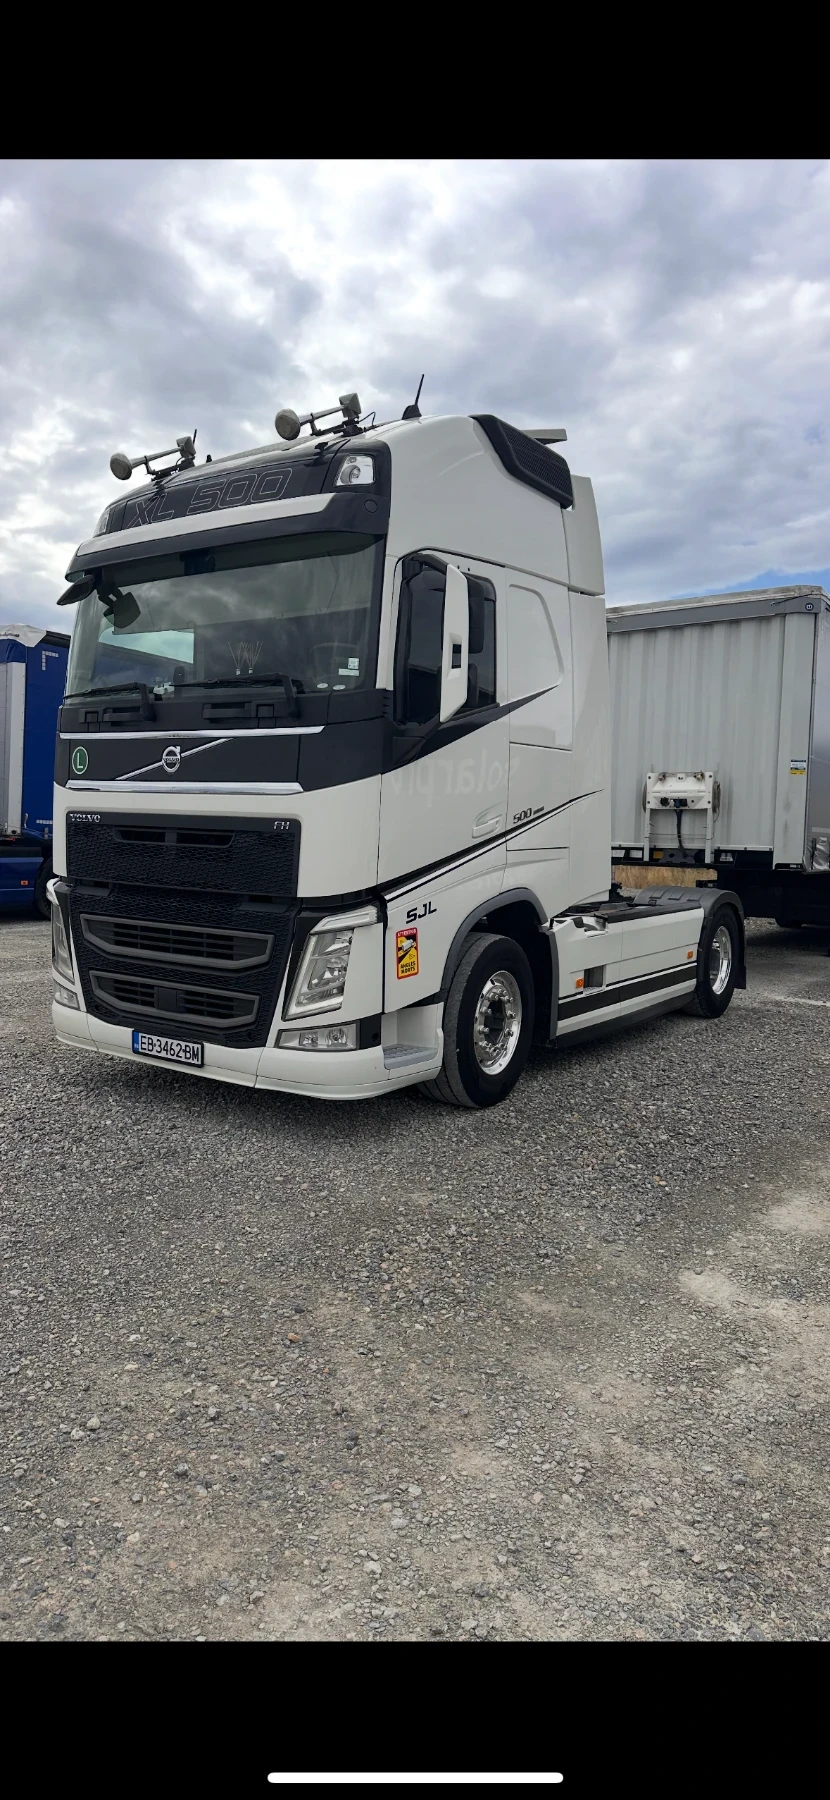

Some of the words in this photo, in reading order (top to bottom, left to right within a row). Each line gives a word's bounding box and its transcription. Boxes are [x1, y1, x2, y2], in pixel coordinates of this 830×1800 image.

[126, 492, 174, 529] XL
[186, 468, 293, 516] 500
[77, 752, 84, 769] L
[69, 813, 101, 823] VOLVO
[513, 807, 532, 824] 500
[273, 821, 290, 830] FH
[406, 901, 437, 924] SJL
